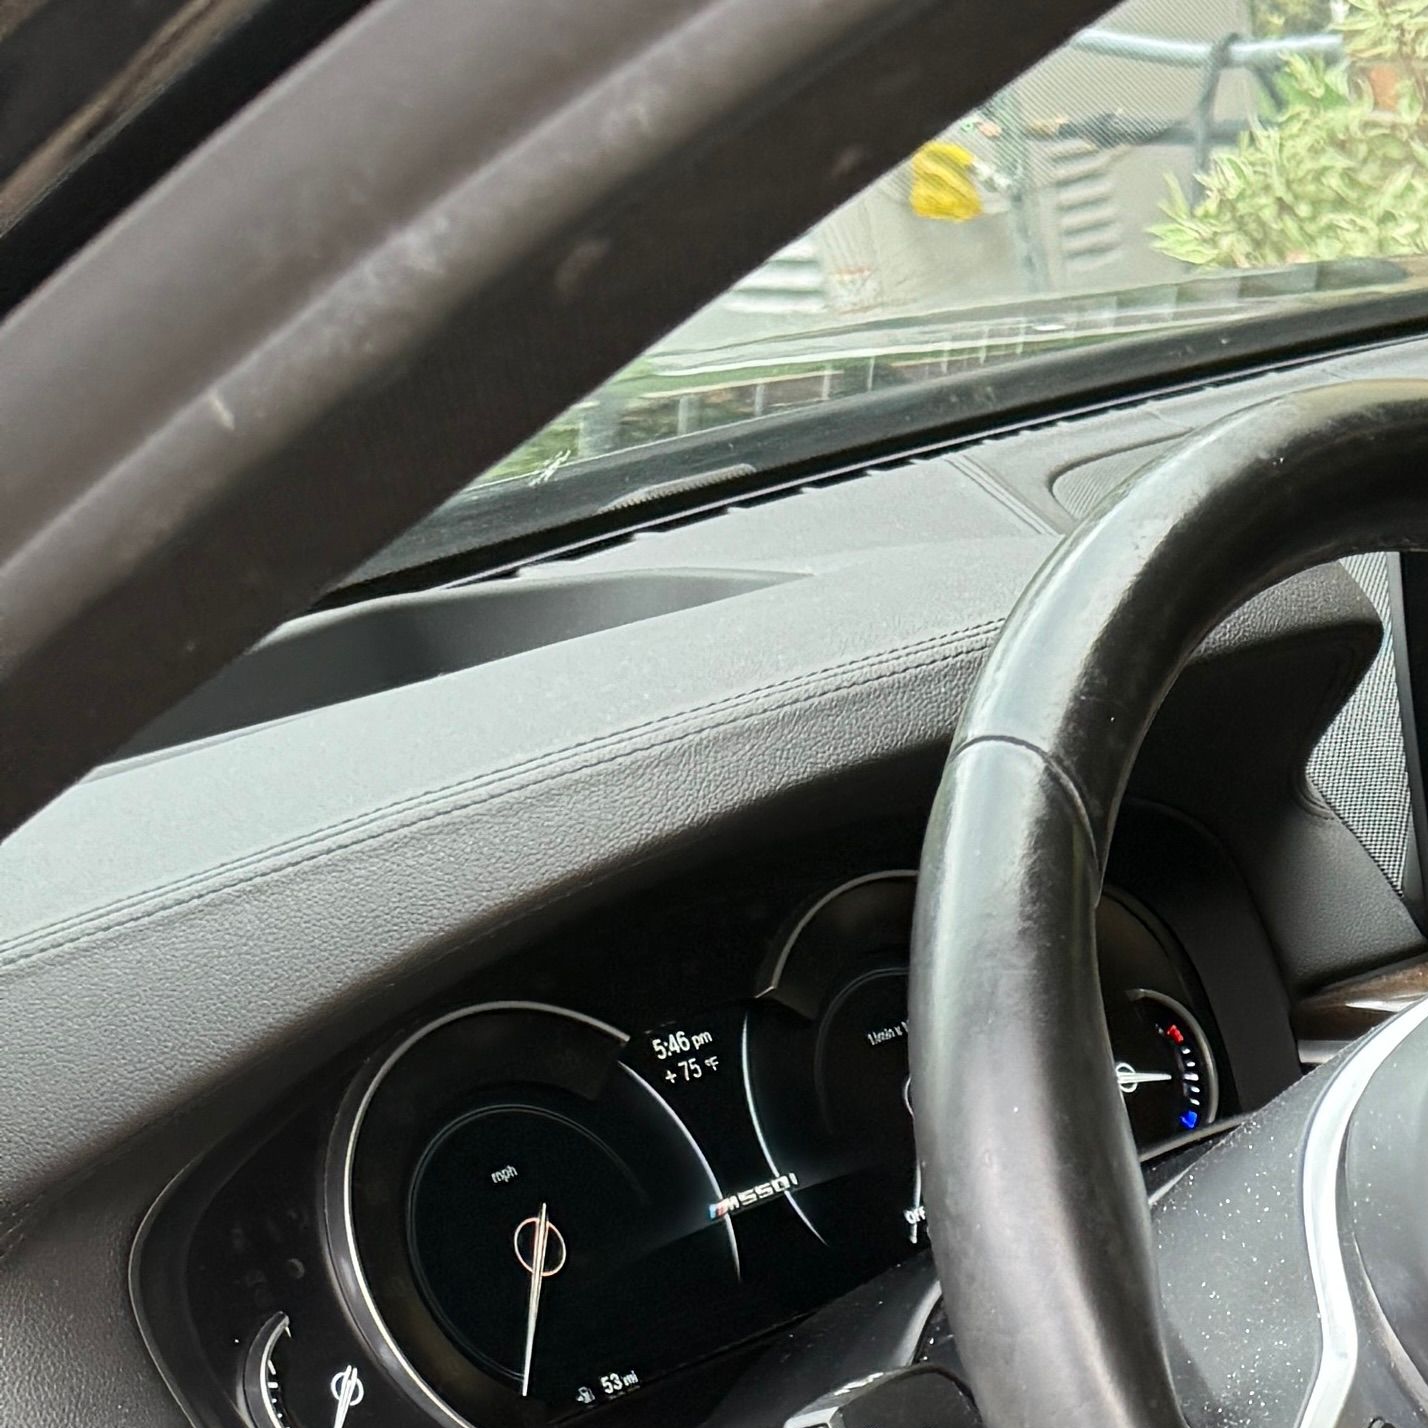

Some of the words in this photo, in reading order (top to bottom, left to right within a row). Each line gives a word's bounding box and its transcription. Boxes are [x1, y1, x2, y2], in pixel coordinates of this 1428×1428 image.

[652, 1030, 690, 1060] 5:46
[691, 1031, 713, 1050] pm
[491, 1165, 518, 1184] mph
[600, 1372, 623, 1394] 53
